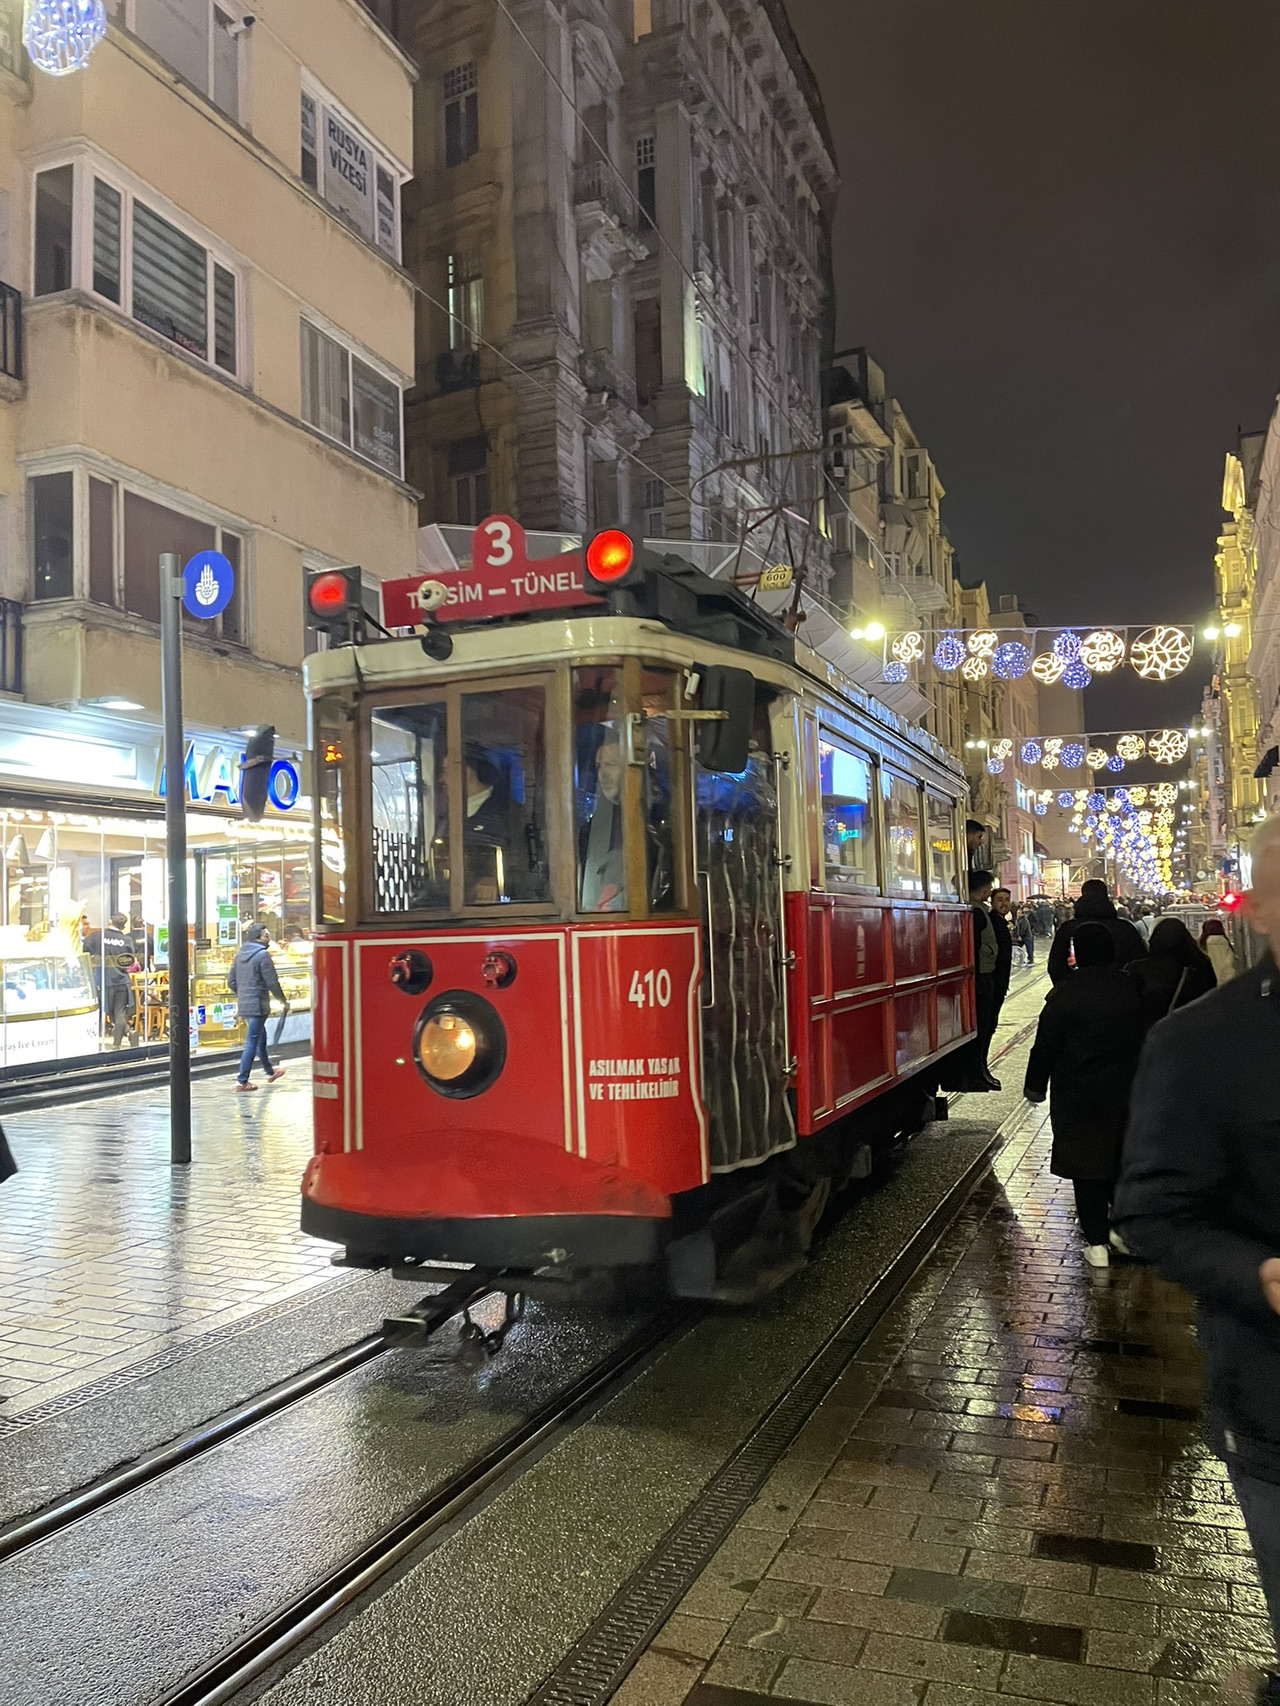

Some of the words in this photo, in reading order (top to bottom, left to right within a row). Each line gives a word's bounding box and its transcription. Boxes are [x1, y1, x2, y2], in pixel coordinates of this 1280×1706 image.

[328, 117, 367, 171] RUSYA
[329, 145, 367, 196] VİZESİ
[484, 521, 513, 566] 3
[406, 581, 482, 609] TSİM
[511, 571, 584, 597] TÜNEL
[766, 573, 786, 582] 600
[628, 968, 671, 1009] 410
[589, 1059, 644, 1076] ASILMAK
[647, 1057, 681, 1075] YASAK
[588, 1083, 604, 1100] VE
[607, 1078, 679, 1100] TEHLİKELİDİR
